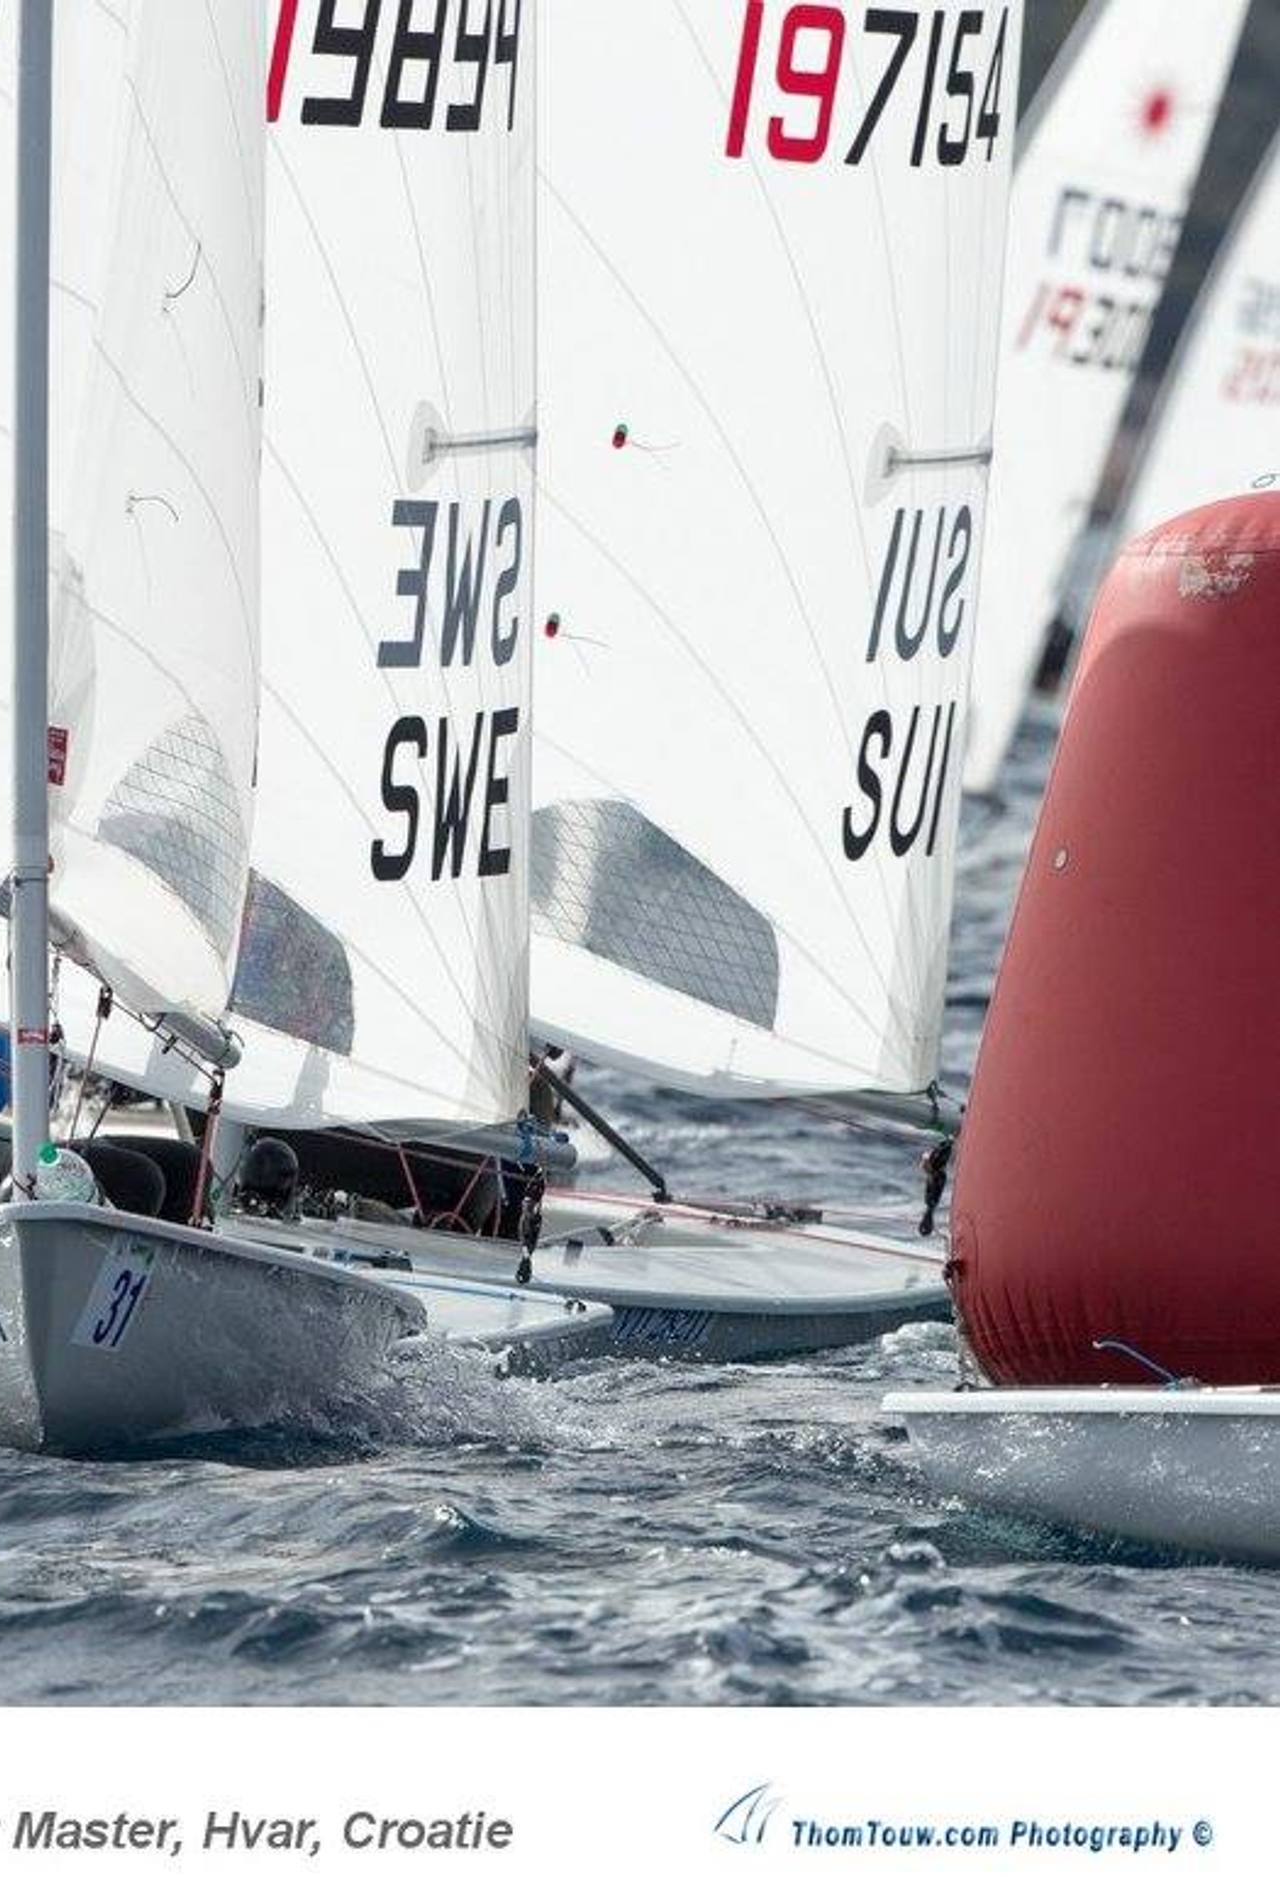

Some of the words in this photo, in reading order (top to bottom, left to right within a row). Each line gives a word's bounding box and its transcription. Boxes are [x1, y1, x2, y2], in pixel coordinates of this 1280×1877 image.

[725, 0, 1009, 167] 197154
[370, 706, 519, 881] SWE
[842, 702, 956, 861] SUI
[92, 1269, 147, 1347] 31
